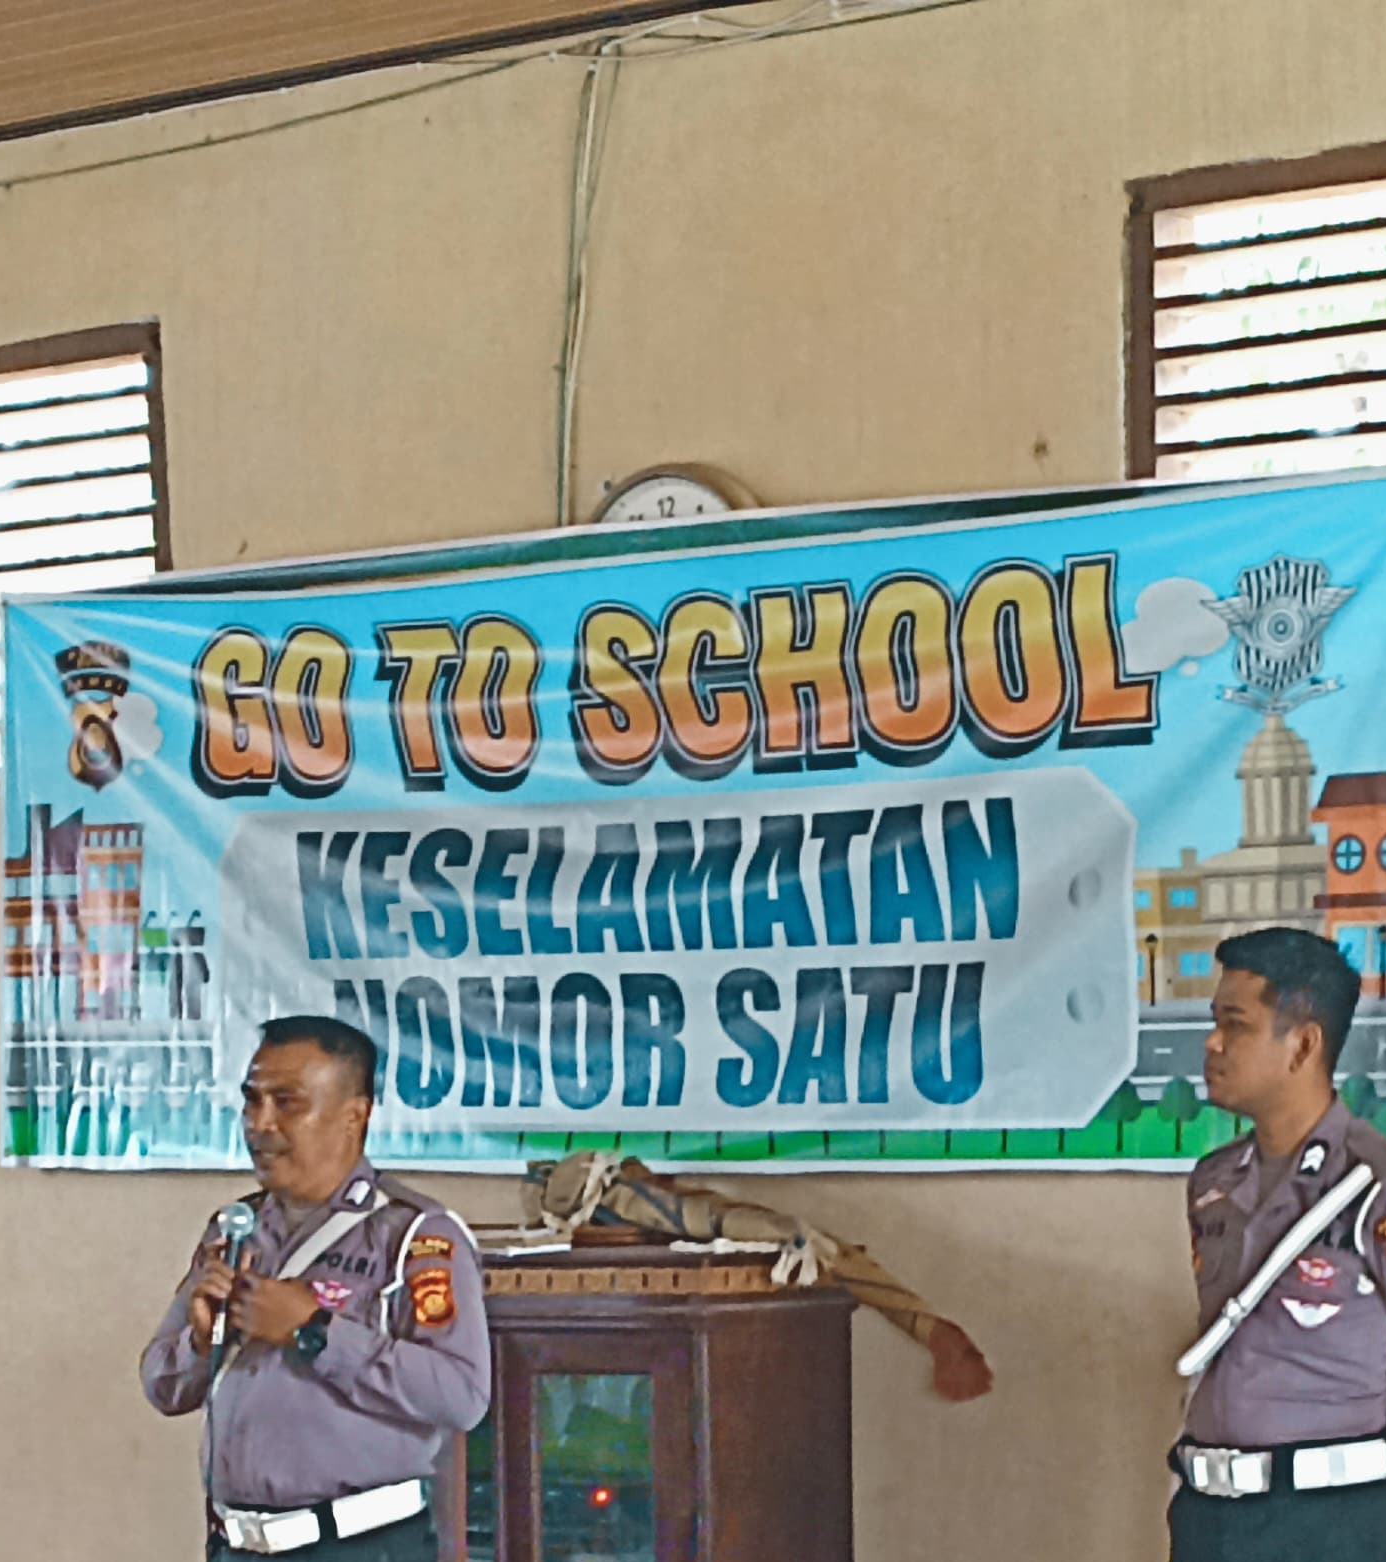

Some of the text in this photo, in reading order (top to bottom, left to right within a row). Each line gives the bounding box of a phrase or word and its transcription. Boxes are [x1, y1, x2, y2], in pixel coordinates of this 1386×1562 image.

[657, 496, 675, 518] 12
[191, 551, 1161, 799] GO TO SCHOOL
[295, 797, 1020, 960] KESELAMATAN
[715, 961, 986, 1108] SATU
